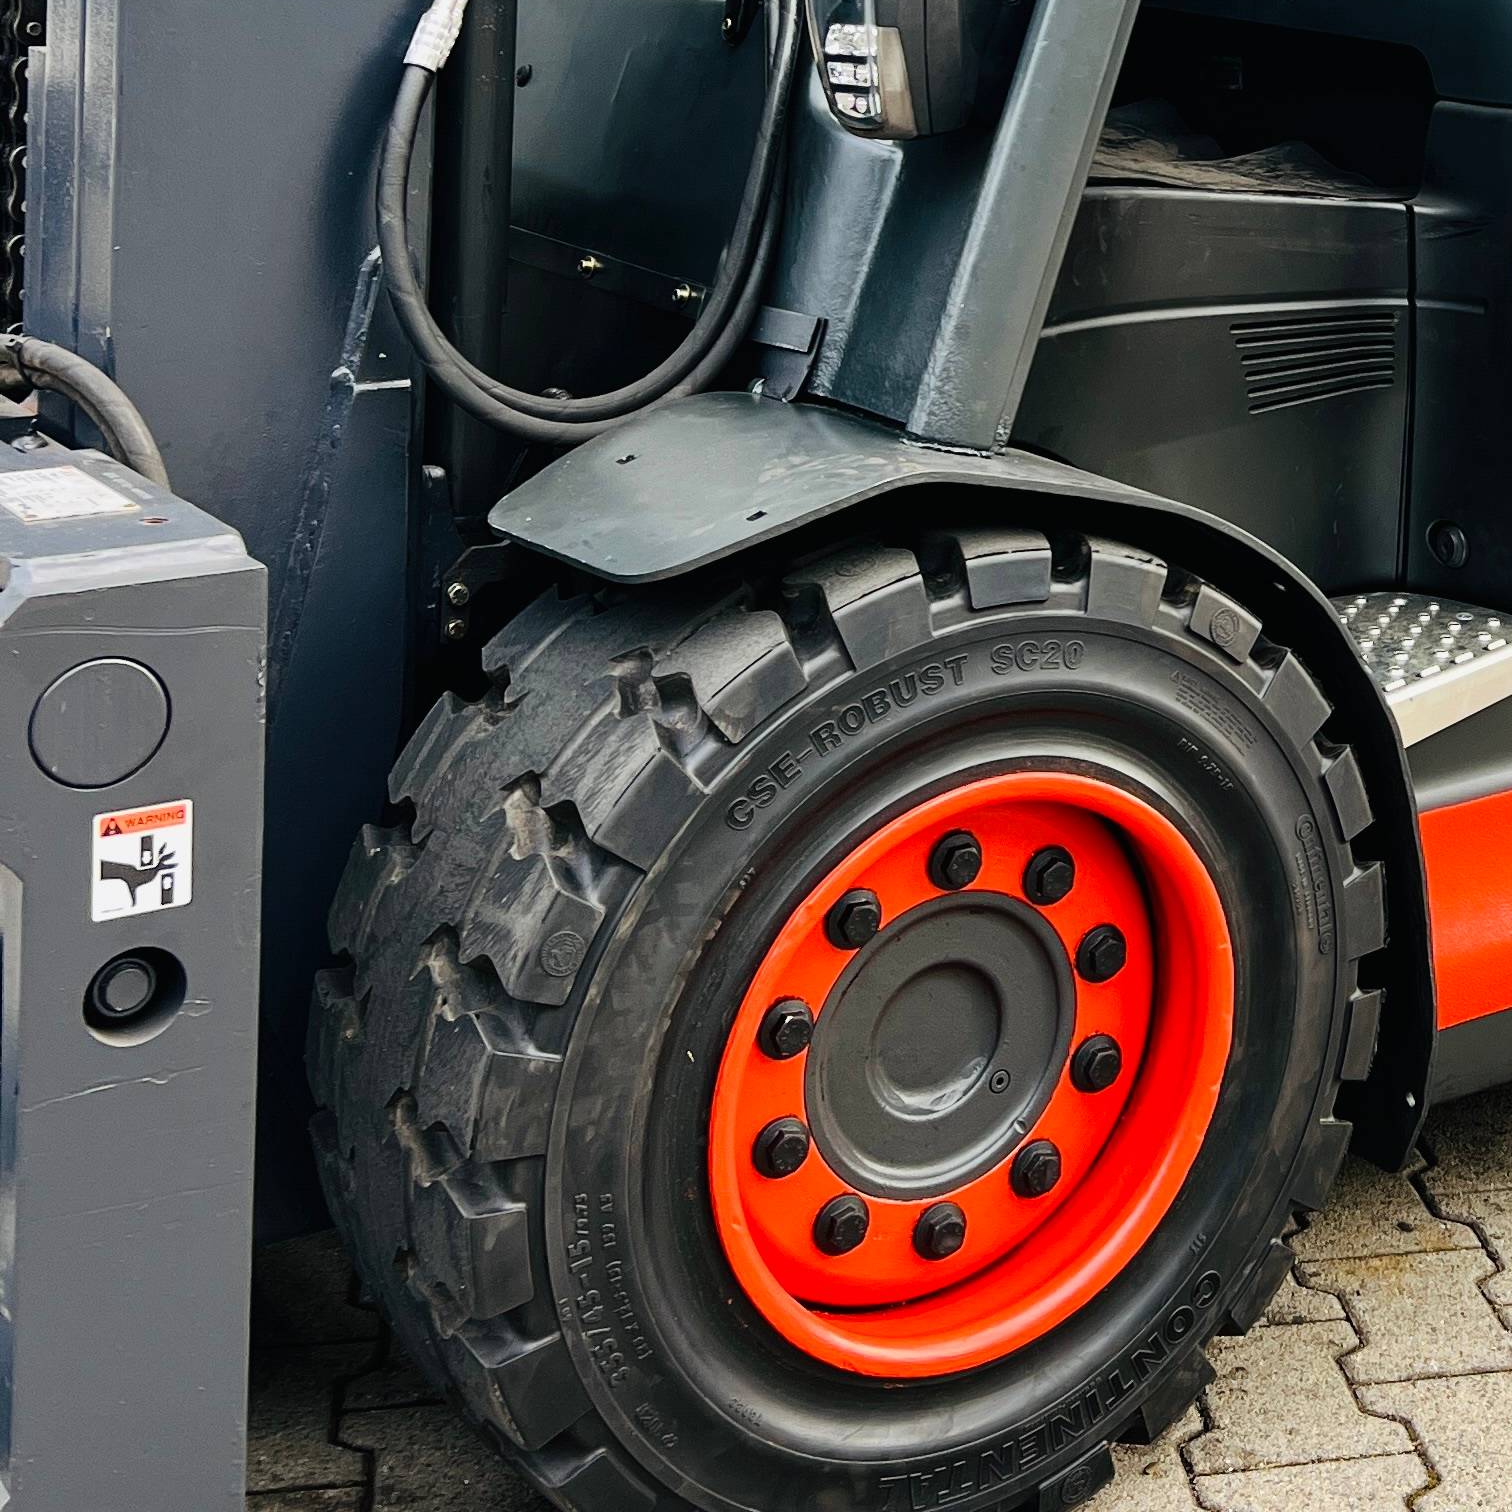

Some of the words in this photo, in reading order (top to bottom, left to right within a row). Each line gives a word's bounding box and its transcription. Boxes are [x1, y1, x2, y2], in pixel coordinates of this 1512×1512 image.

[124, 809, 185, 828] WARNING
[725, 652, 970, 832] CSE-ROBUST
[990, 639, 1086, 676] SC20
[879, 1269, 1222, 1512] CONTINENTAL
